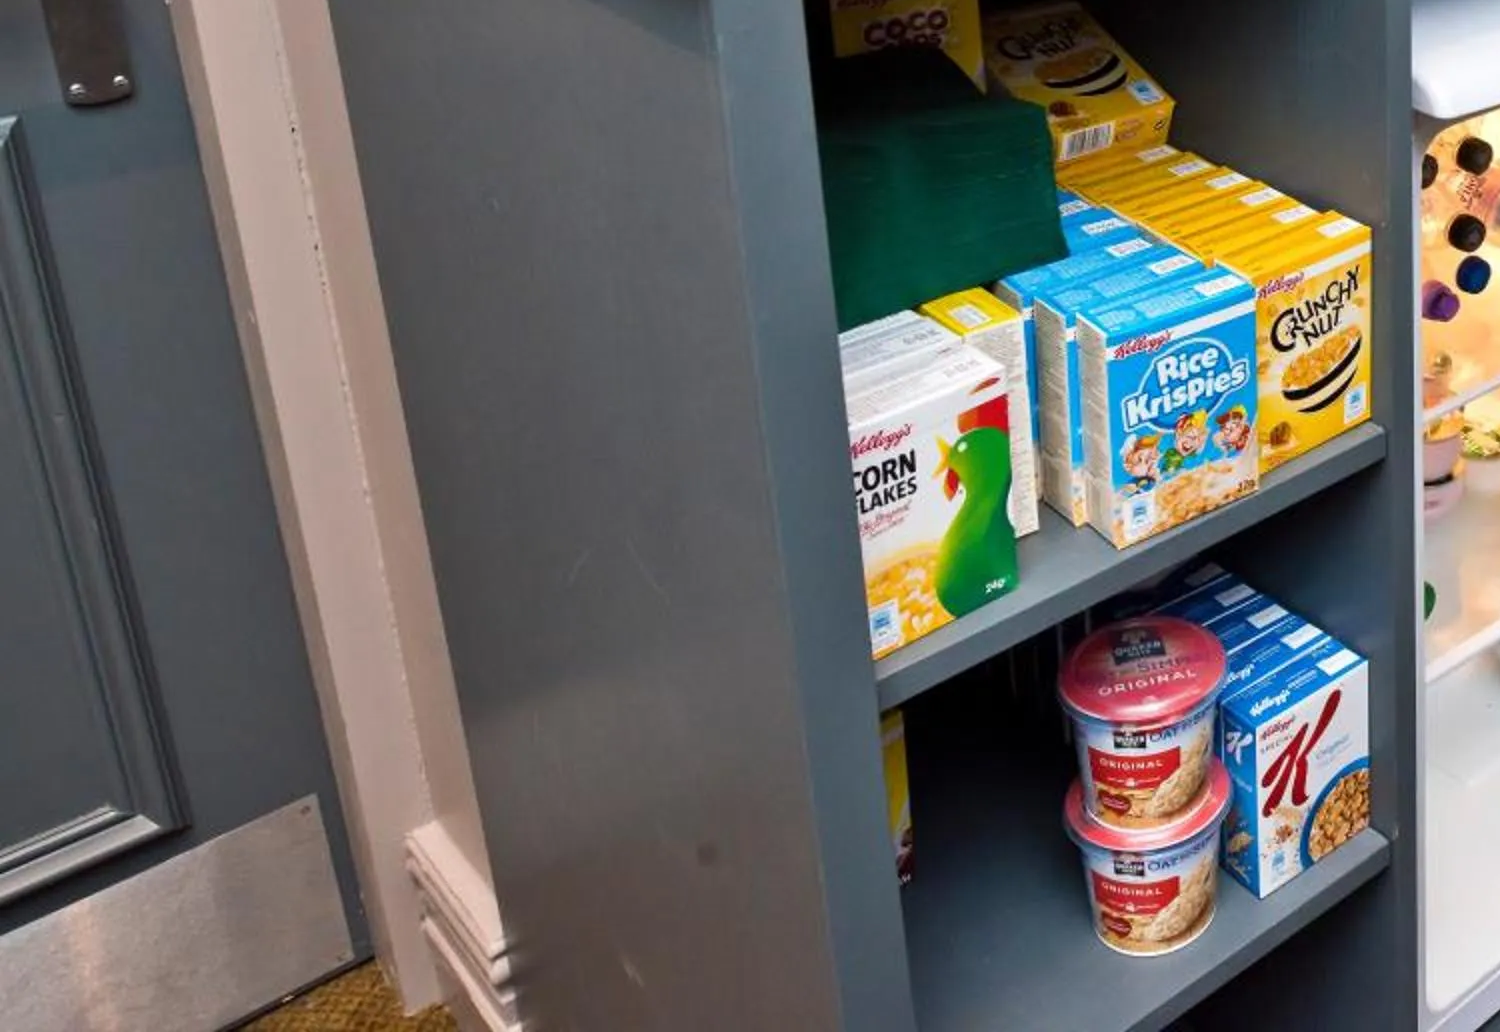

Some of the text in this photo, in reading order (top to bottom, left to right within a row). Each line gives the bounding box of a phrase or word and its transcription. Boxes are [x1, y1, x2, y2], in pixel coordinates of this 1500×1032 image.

[864, 9, 948, 45] COCO
[1270, 264, 1360, 352] CRUNCHY
[1302, 303, 1344, 347] NUT
[1113, 330, 1171, 359] Kellogg's
[1156, 347, 1219, 387] Rice
[1126, 363, 1246, 426] Krispies
[856, 476, 917, 514] LAKES
[1098, 670, 1197, 696] ORIGINAL
[1100, 758, 1164, 771] ORIGINAL
[1262, 689, 1342, 818] K
[1101, 882, 1164, 897] ORIGINAL
